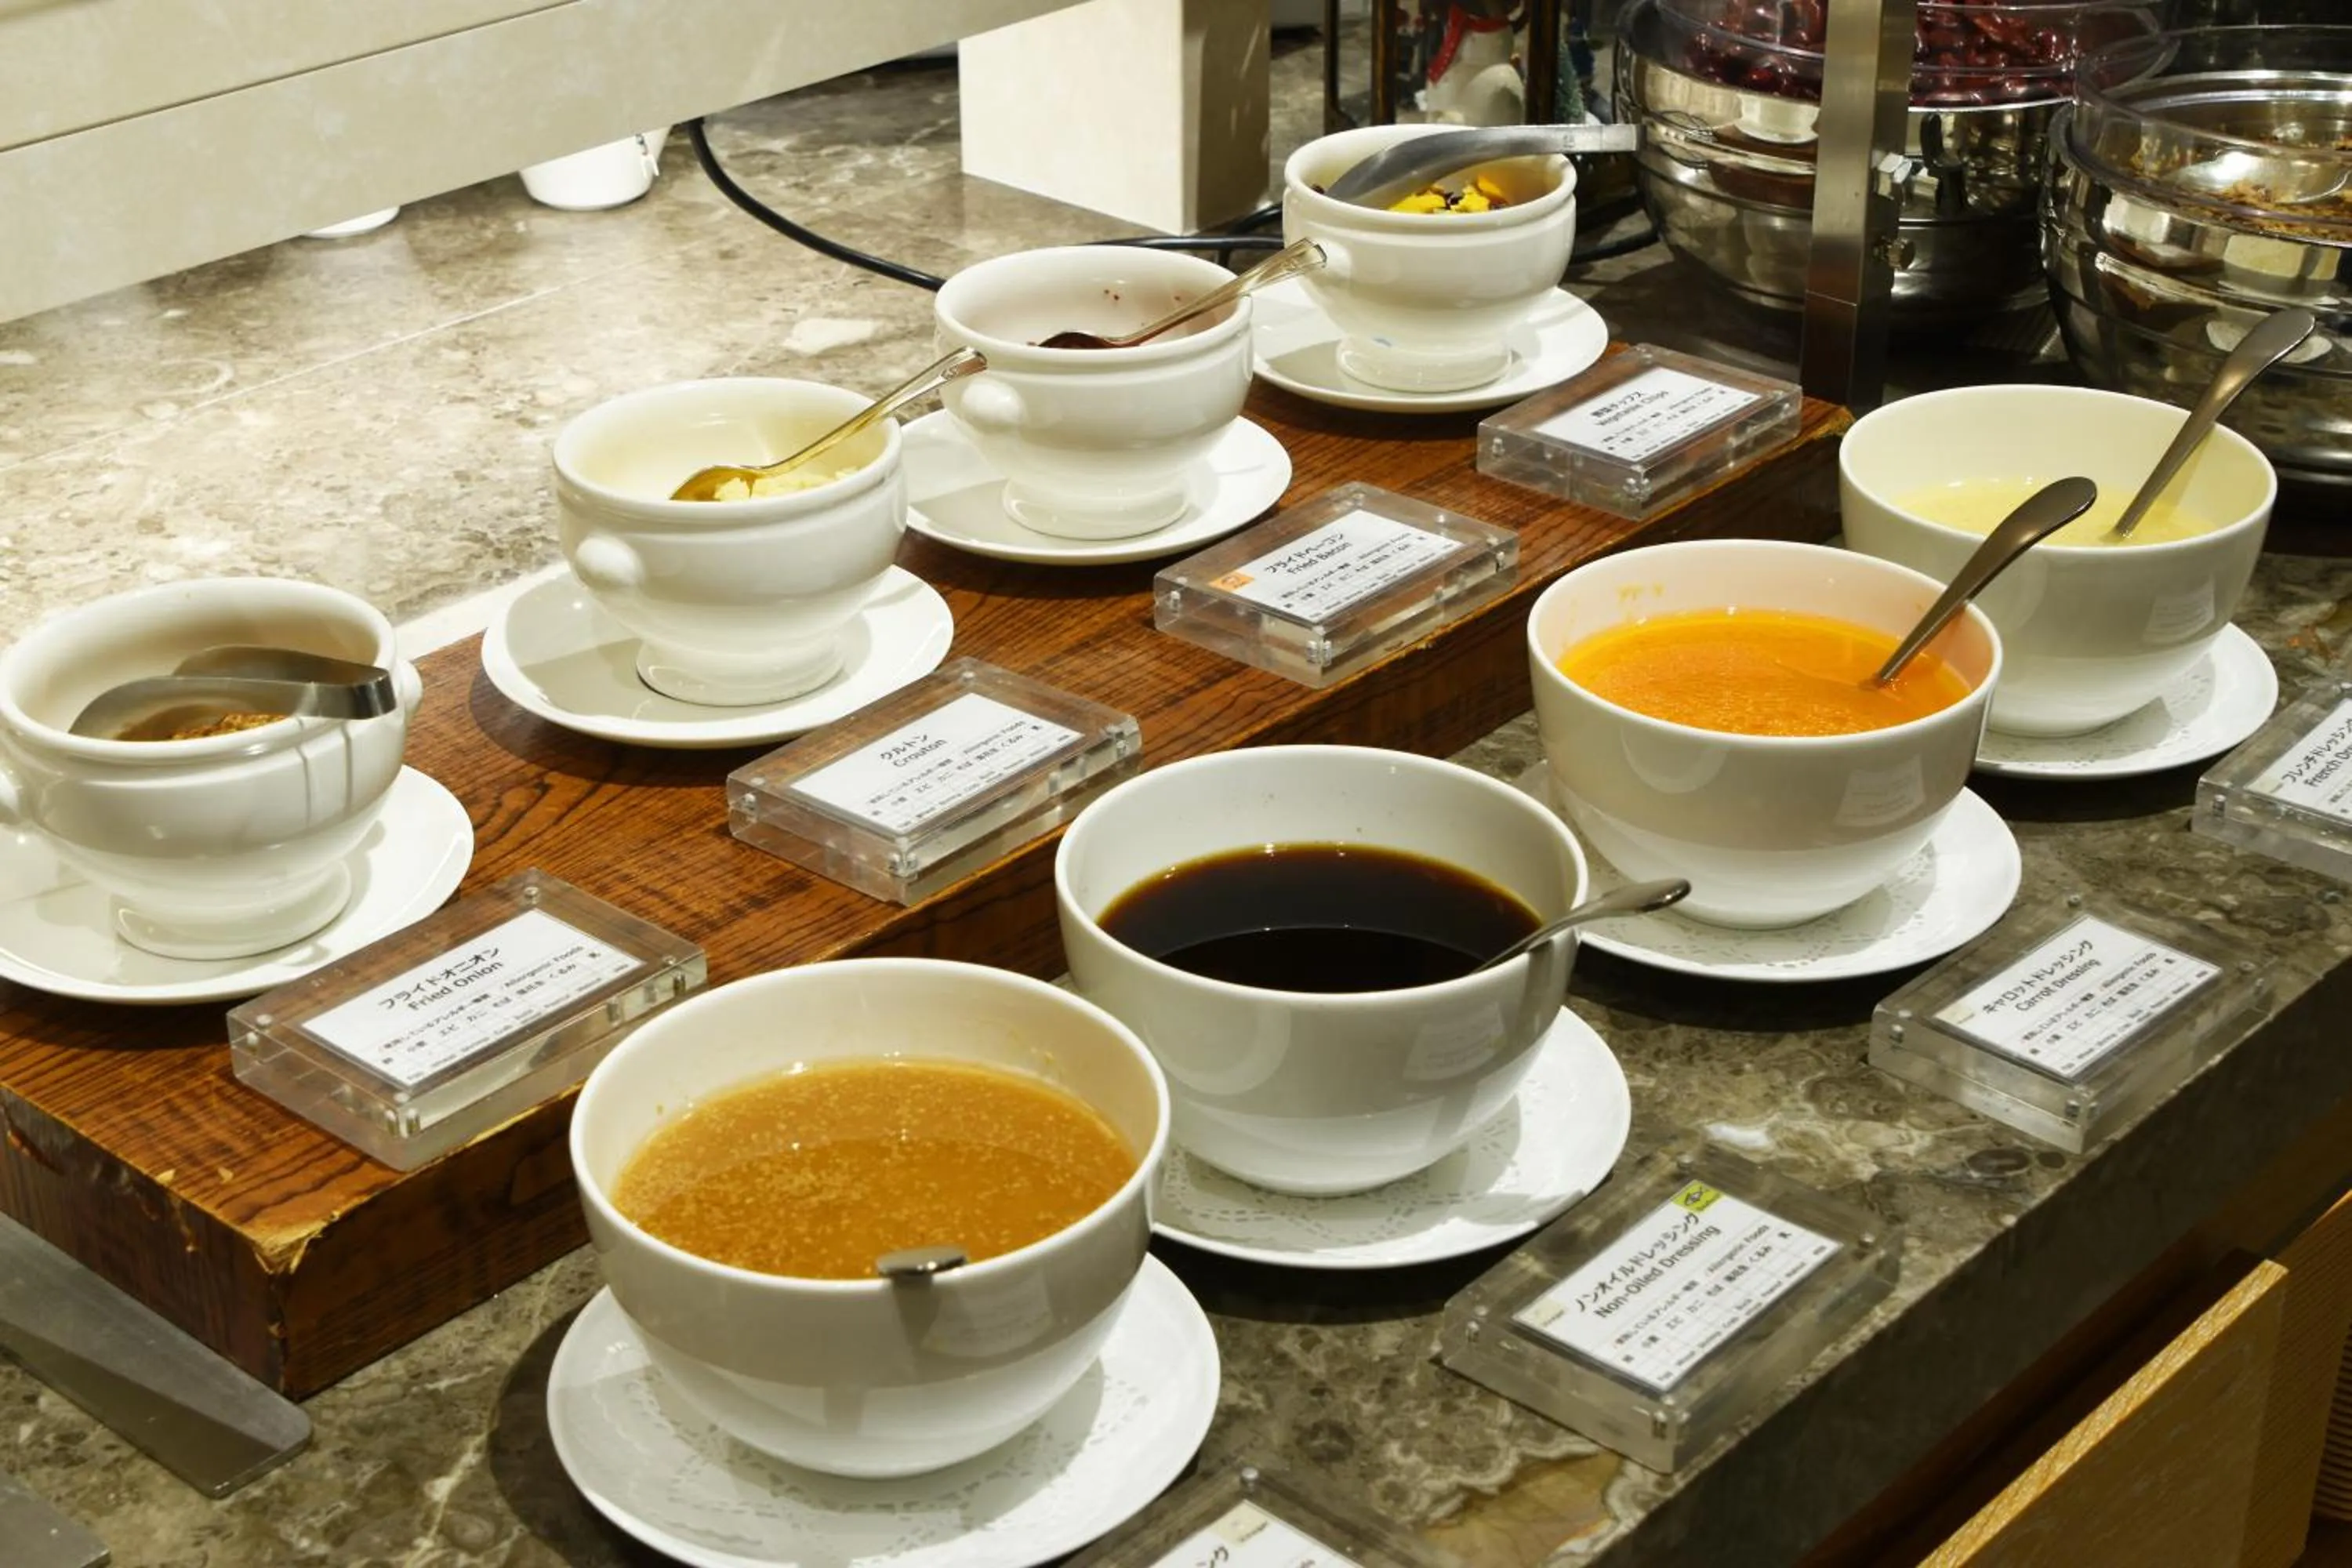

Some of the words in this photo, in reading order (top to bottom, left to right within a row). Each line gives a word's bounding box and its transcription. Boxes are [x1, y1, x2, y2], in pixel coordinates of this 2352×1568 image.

[1286, 557, 1319, 575] Fried
[1315, 542, 1352, 561] Bacon
[880, 734, 928, 760] クルトン
[892, 739, 948, 768] Crouton
[2303, 759, 2343, 788] French
[379, 947, 499, 1010] フライドオニオン
[407, 985, 454, 1011] Fried
[452, 962, 504, 988] Onion
[1982, 939, 2093, 1014] キャロットドレッシング
[2014, 985, 2057, 1011] Carrot
[2050, 958, 2102, 989] Dressing
[1575, 1211, 1700, 1313] ノンオイルドレッシング
[1592, 1266, 1664, 1319] Non-Oiled
[1657, 1225, 1722, 1269] Dressing
